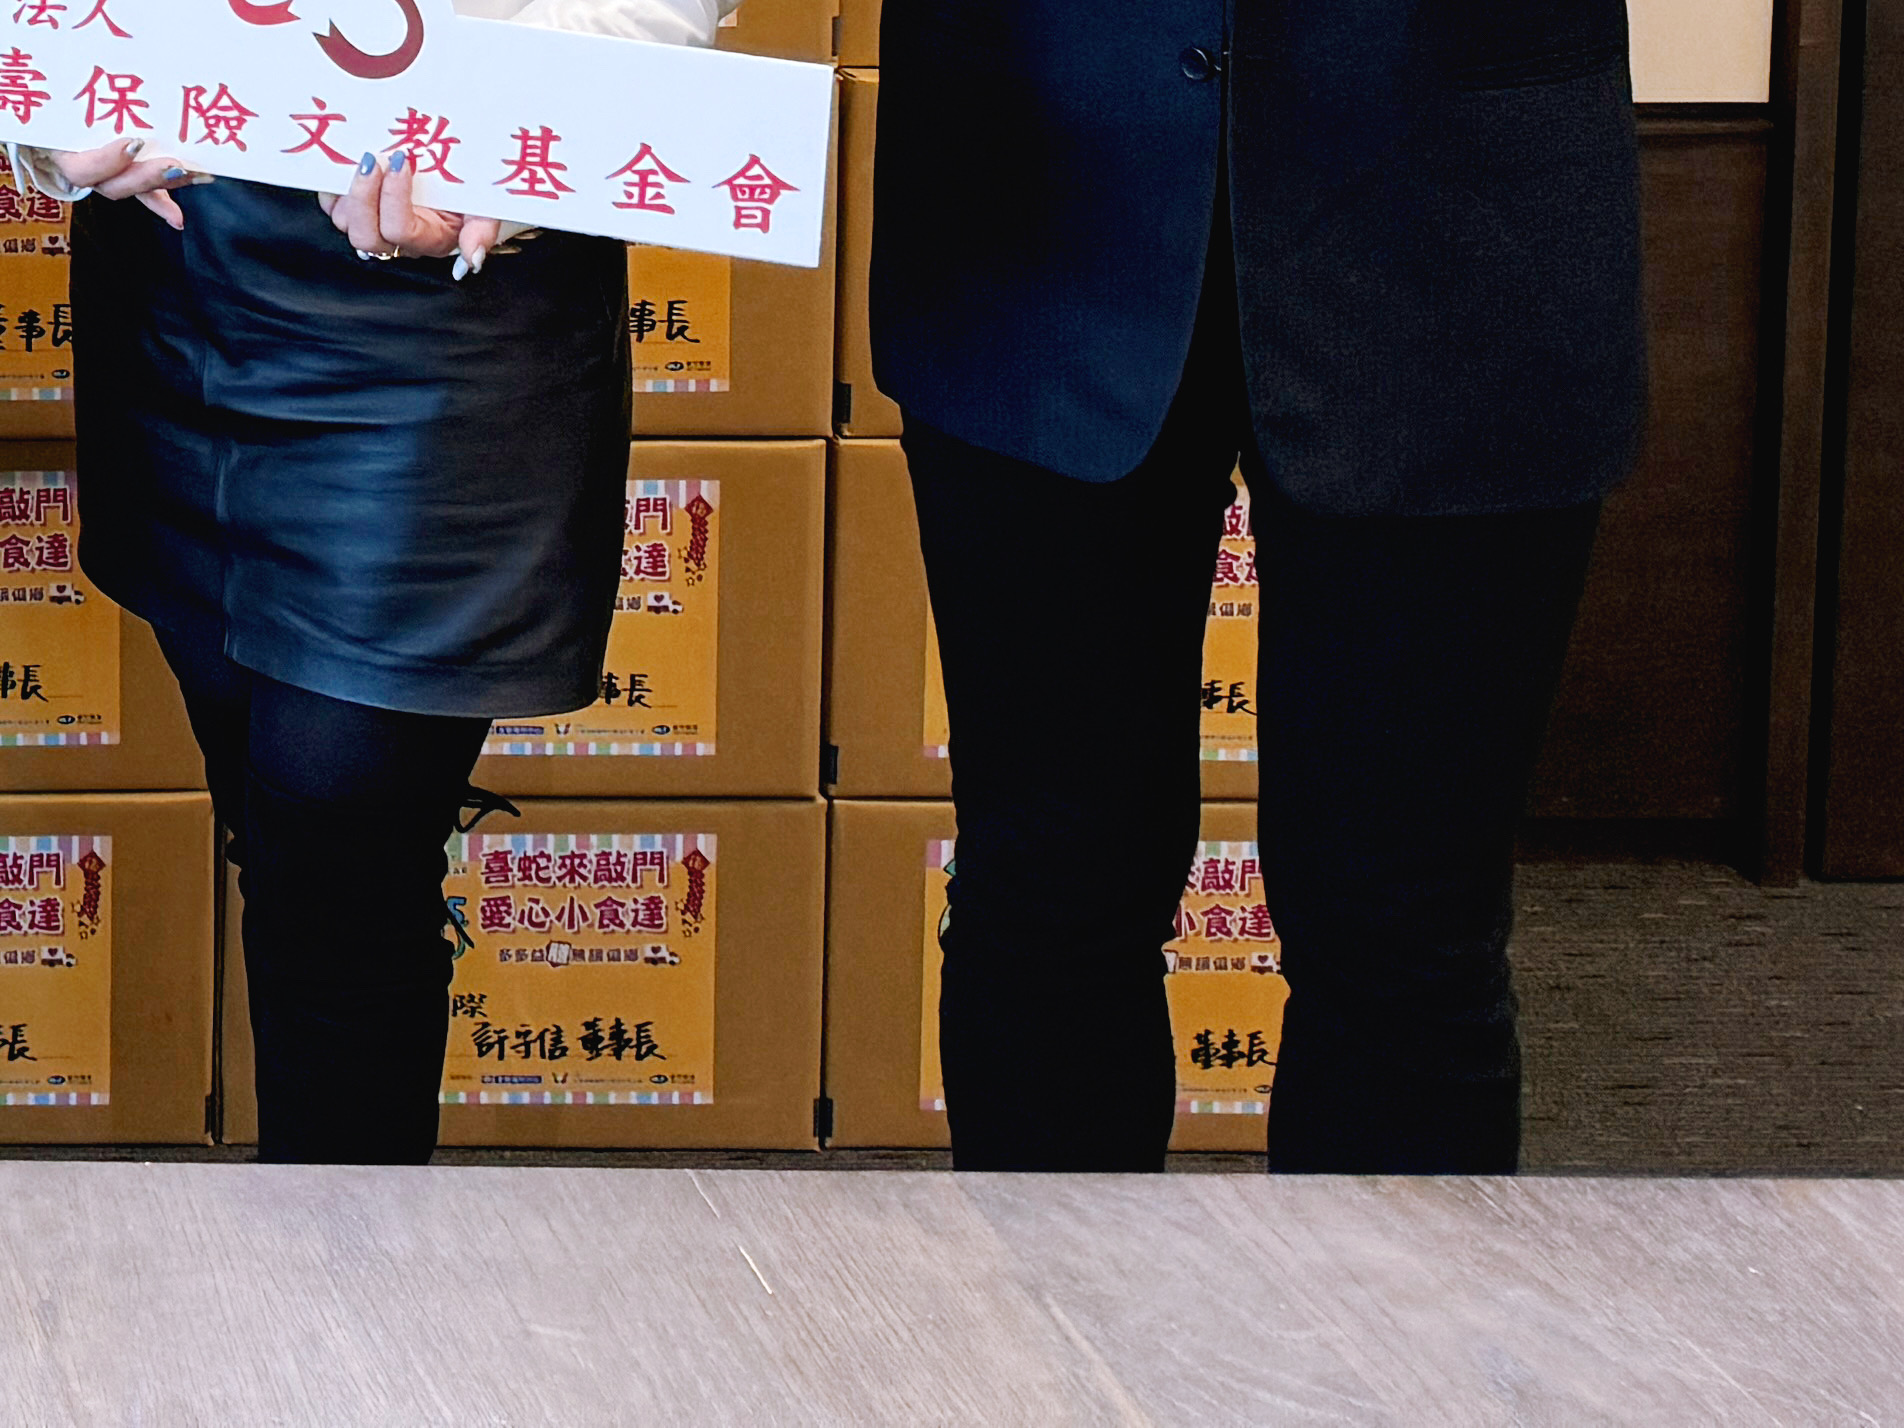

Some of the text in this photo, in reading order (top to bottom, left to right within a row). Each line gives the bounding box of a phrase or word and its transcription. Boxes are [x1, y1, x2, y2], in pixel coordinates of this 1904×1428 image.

[480, 850, 667, 885] 喜蛇來敲門
[479, 894, 666, 930] 愛心小食達
